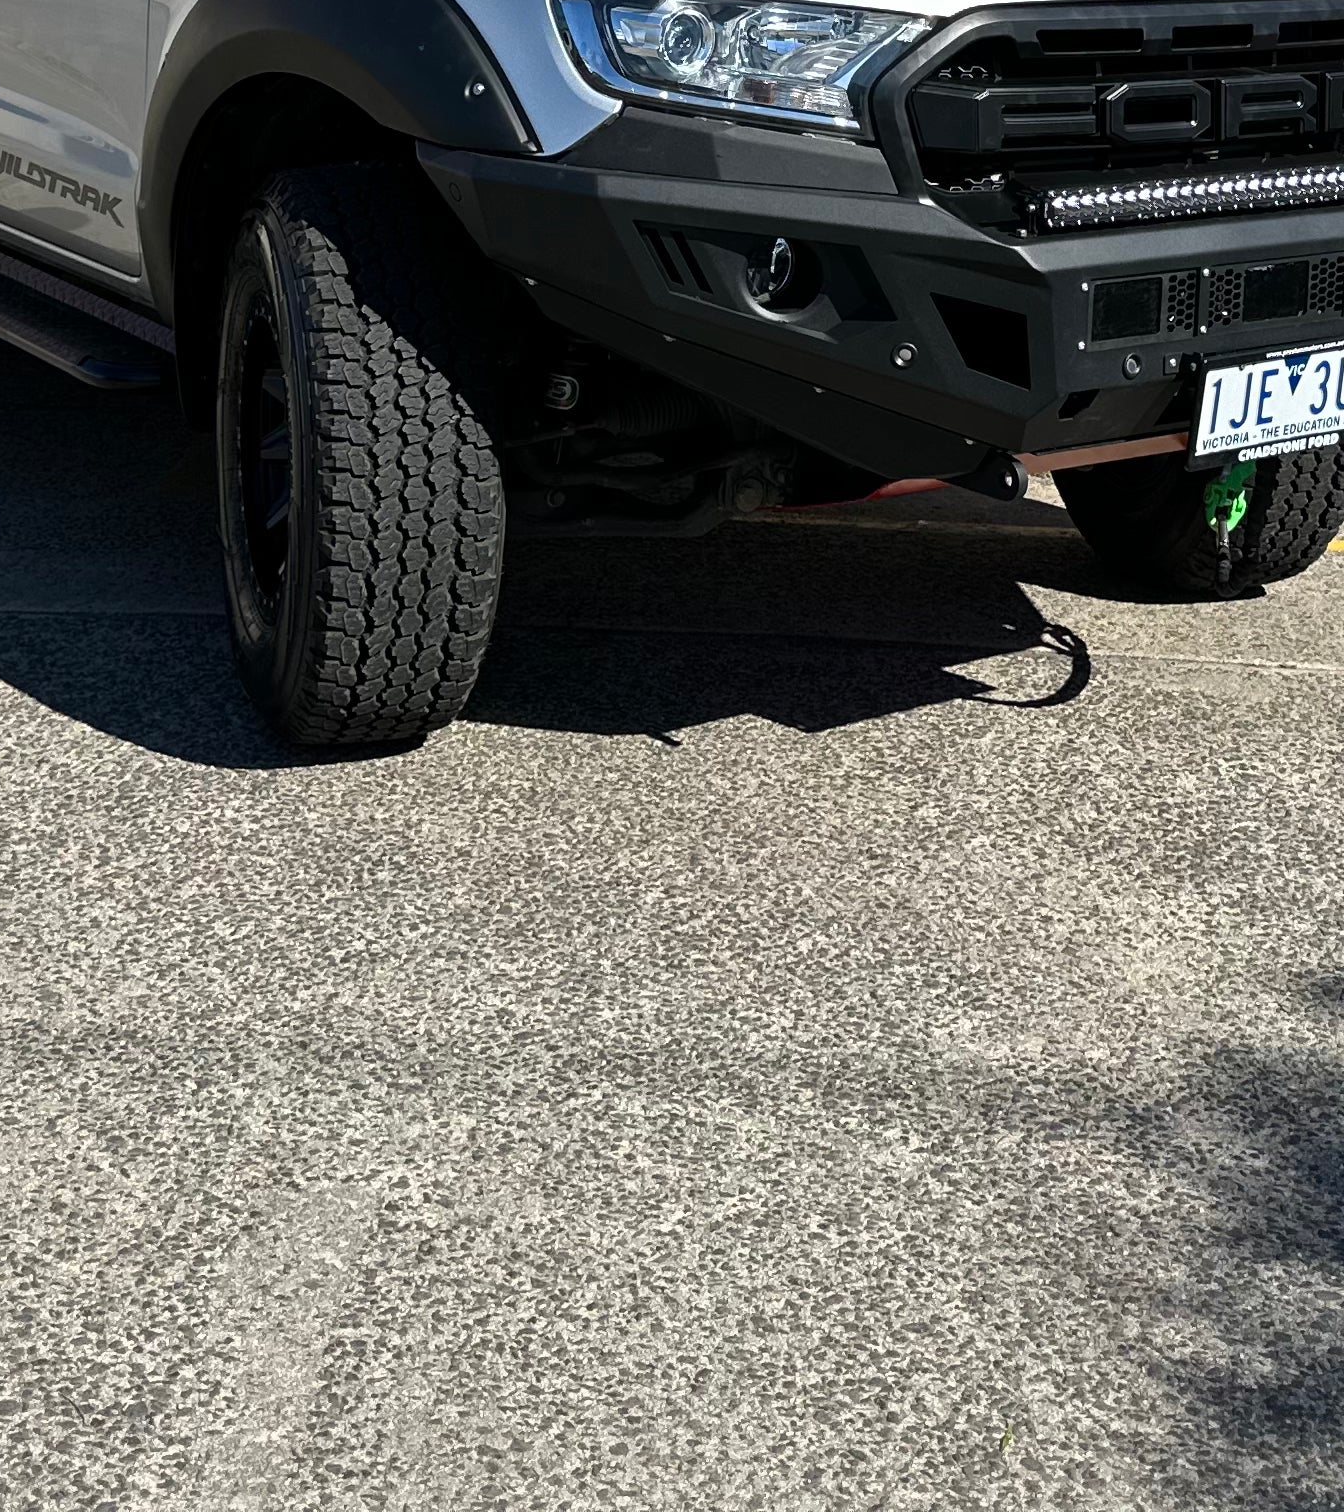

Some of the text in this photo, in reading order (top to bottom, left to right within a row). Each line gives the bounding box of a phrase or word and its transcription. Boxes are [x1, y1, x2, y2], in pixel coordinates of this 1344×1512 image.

[1202, 433, 1250, 451] VICTORIA
[1260, 425, 1280, 438] THE
[1283, 417, 1341, 436] EDUCATION
[1238, 433, 1340, 462] CHADSTONE FORD
